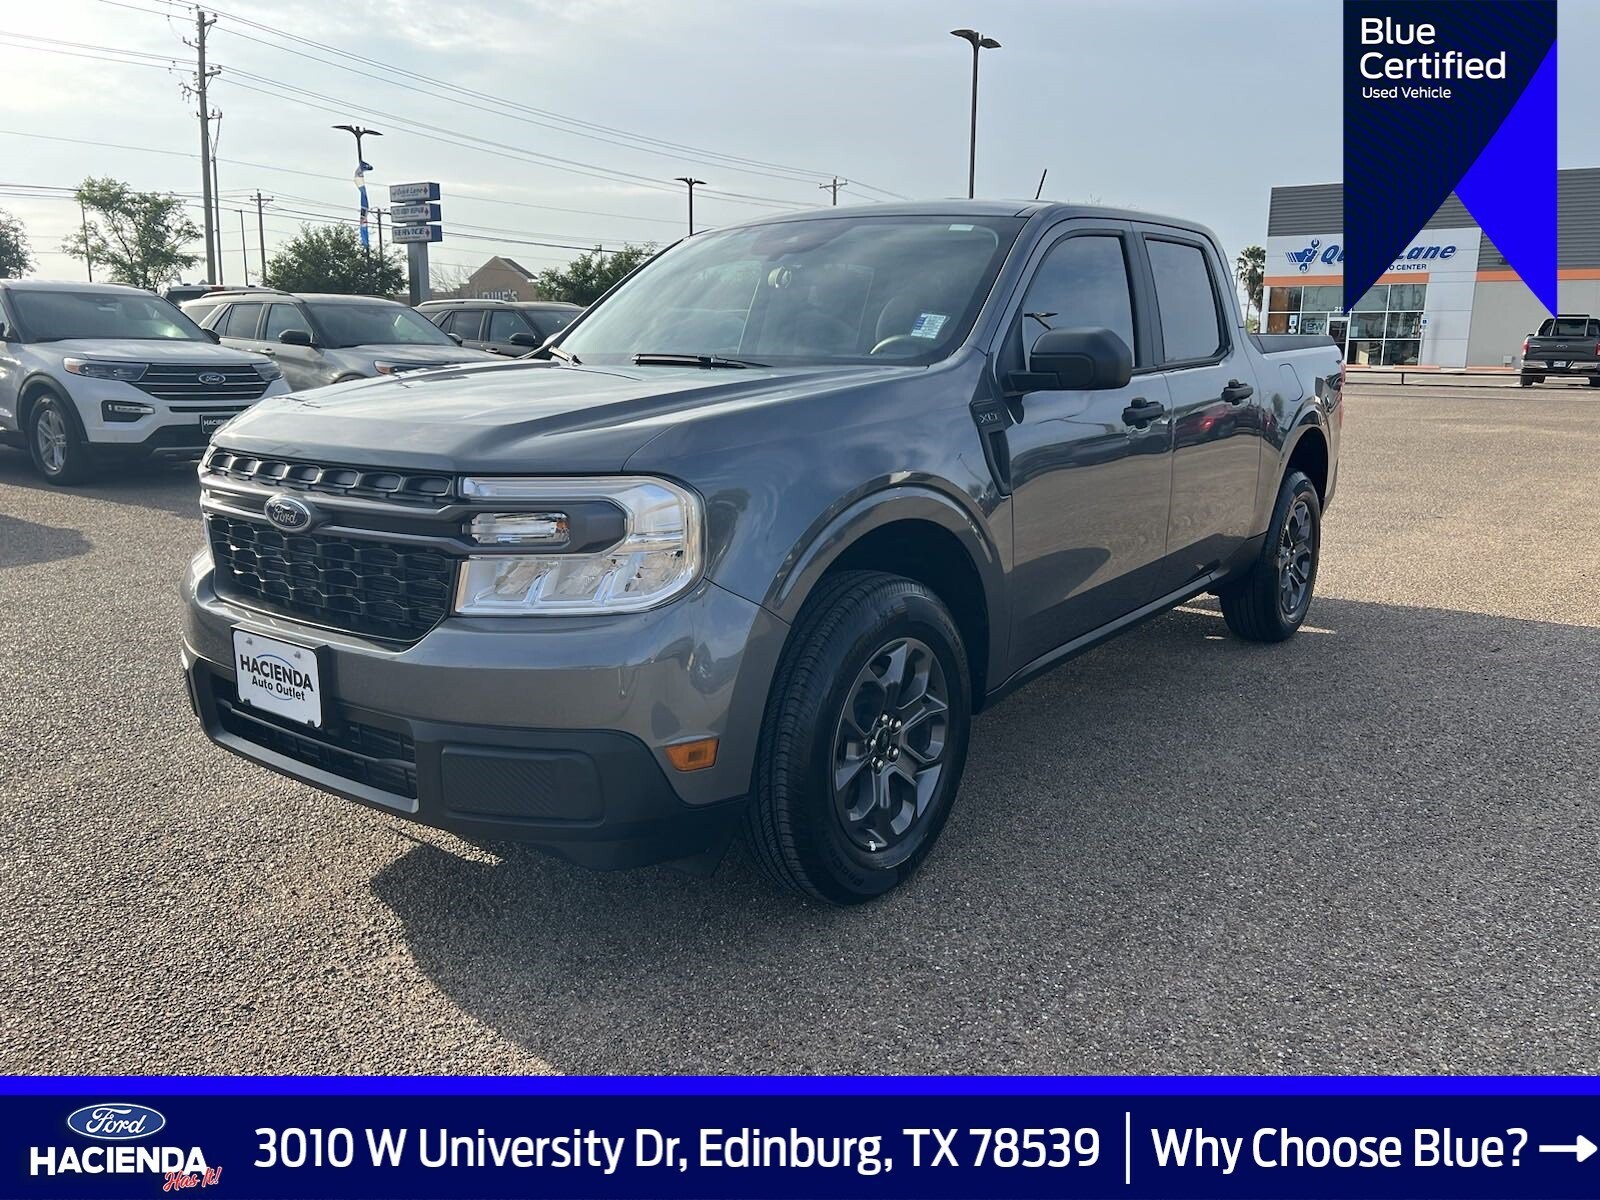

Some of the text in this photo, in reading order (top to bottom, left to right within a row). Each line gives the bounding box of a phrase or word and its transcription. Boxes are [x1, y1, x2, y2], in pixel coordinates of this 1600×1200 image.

[394, 227, 425, 237] SERVICE
[1396, 263, 1427, 271] CENTER
[979, 413, 998, 423] XLT
[272, 503, 298, 524] Ford
[240, 654, 314, 692] HACIENDA
[251, 675, 306, 701] Auto Outlet
